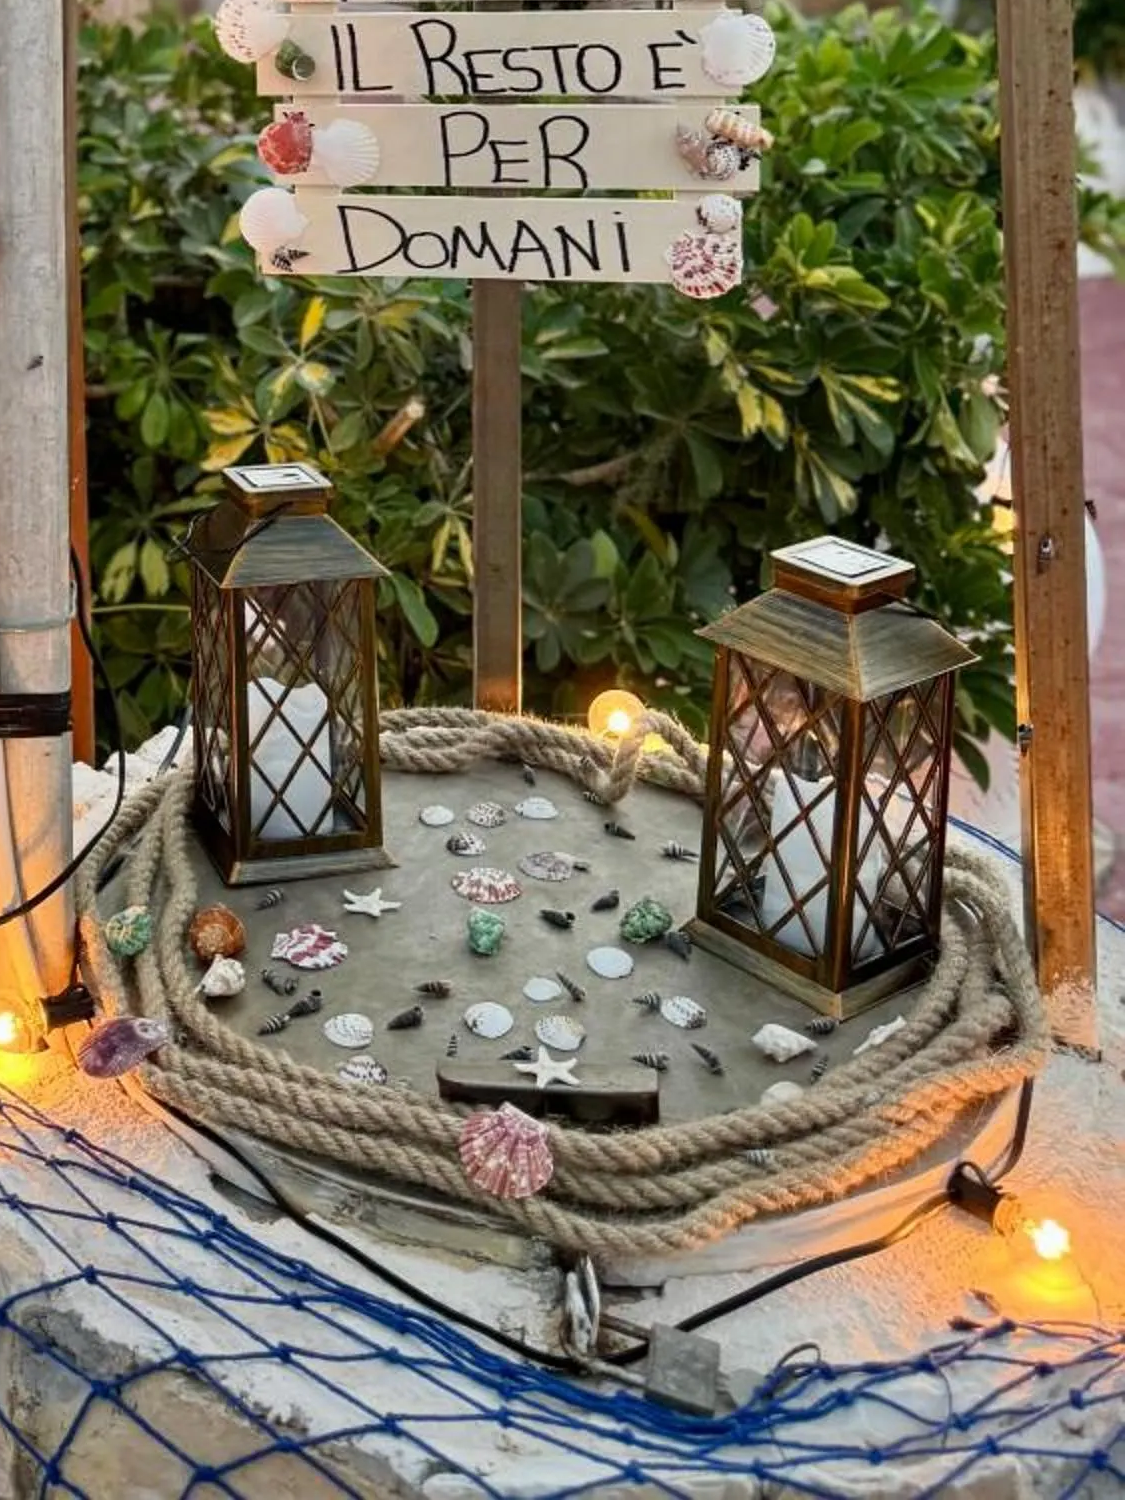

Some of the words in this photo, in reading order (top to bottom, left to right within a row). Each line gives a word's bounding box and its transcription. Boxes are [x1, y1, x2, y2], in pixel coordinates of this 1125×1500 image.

[330, 23, 394, 92] IL
[410, 19, 622, 96] RESTO
[647, 30, 697, 91] È
[439, 111, 590, 189] PER
